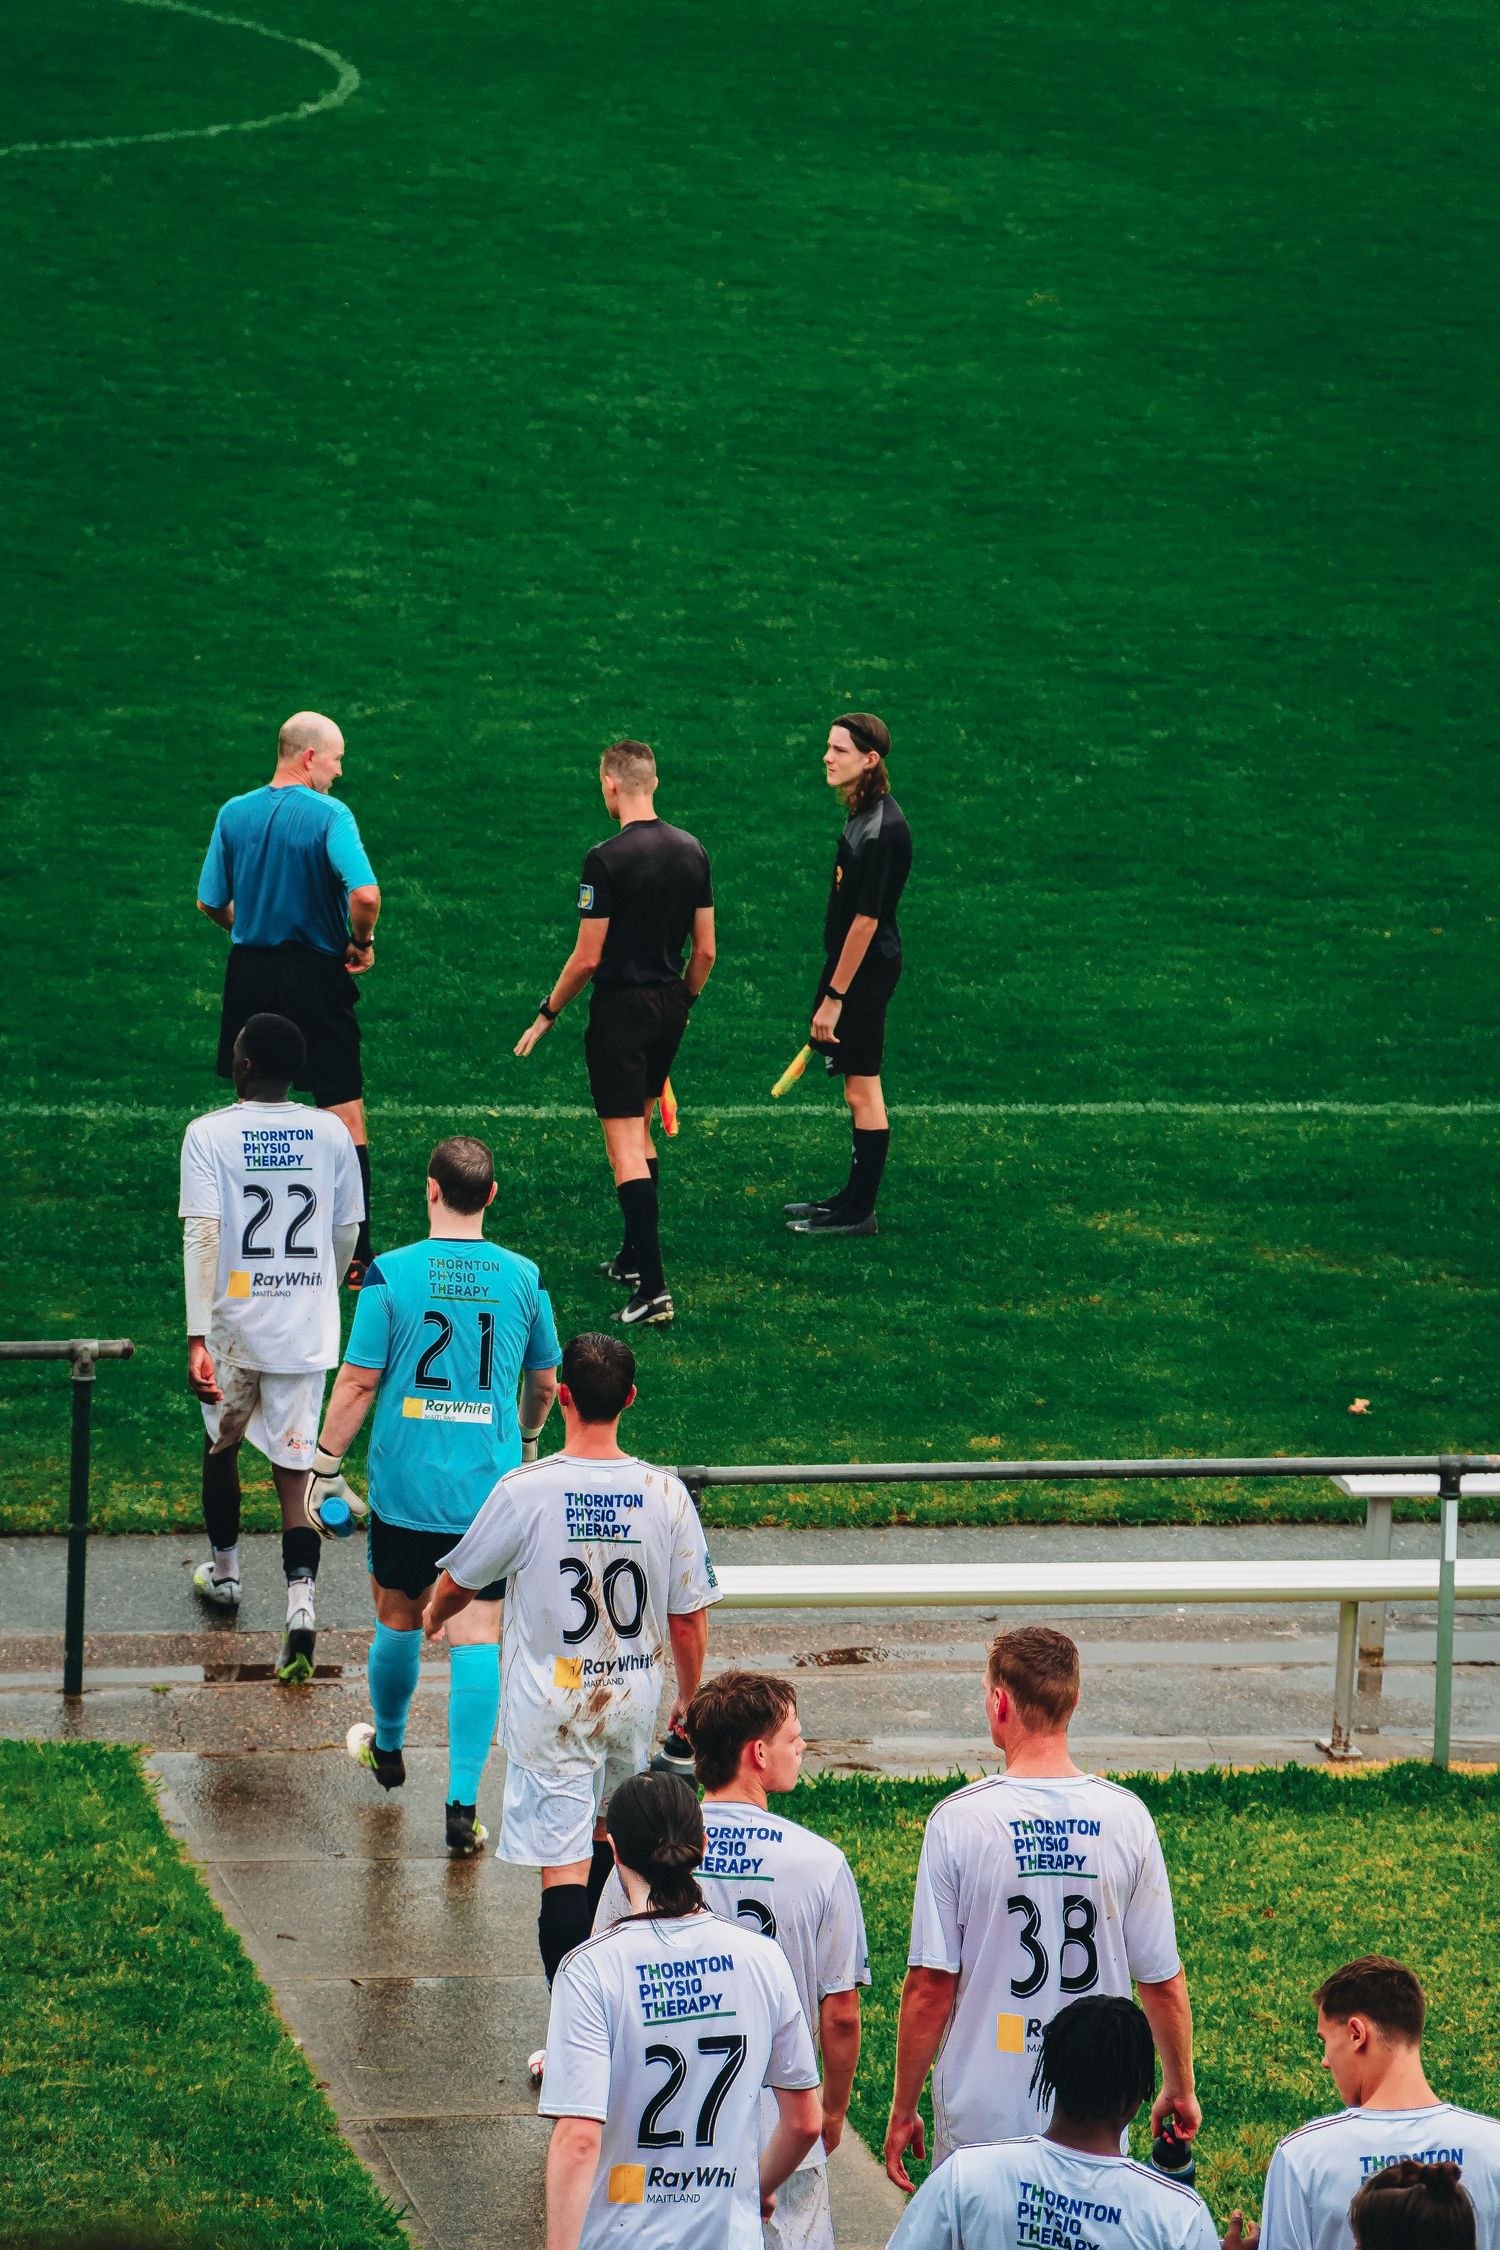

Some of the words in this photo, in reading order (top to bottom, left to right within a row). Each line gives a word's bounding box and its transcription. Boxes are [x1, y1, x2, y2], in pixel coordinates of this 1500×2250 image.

[242, 1129, 313, 1141] THORNTON
[243, 1143, 290, 1154] PHYSIO
[245, 1155, 304, 1167] THERAPY
[241, 1183, 318, 1259] 22
[428, 1257, 500, 1273] THORNTON
[429, 1270, 476, 1284] PHYSIO
[430, 1283, 490, 1297] THERAPY
[414, 1310, 495, 1391] 21
[425, 1400, 491, 1415] RayWhite
[564, 1493, 644, 1508] THORNTON
[566, 1508, 616, 1522] PHYSIO
[567, 1523, 631, 1538] THERAPY
[559, 1557, 648, 1645] 30
[584, 1677, 624, 1688] MAITLAND
[703, 1826, 783, 1843] ORNTON
[1009, 1819, 1101, 1837] THORNTON
[706, 1841, 747, 1856] YSIO
[1013, 1836, 1069, 1854] PHYSIO
[699, 1857, 763, 1874] ERAPY
[1016, 1855, 1087, 1871] THERAPY
[1007, 1894, 1099, 1999] 38
[635, 1954, 735, 1982] THORNTON
[638, 1978, 703, 2000] PHYSIO
[641, 1993, 723, 2019] THERAPY
[637, 2034, 748, 2149] 27
[647, 2166, 737, 2191] RayWhi
[646, 2193, 701, 2203] MAITLAND
[1020, 2182, 1122, 2225] THORNTON
[1017, 2202, 1082, 2236] PHYSIO
